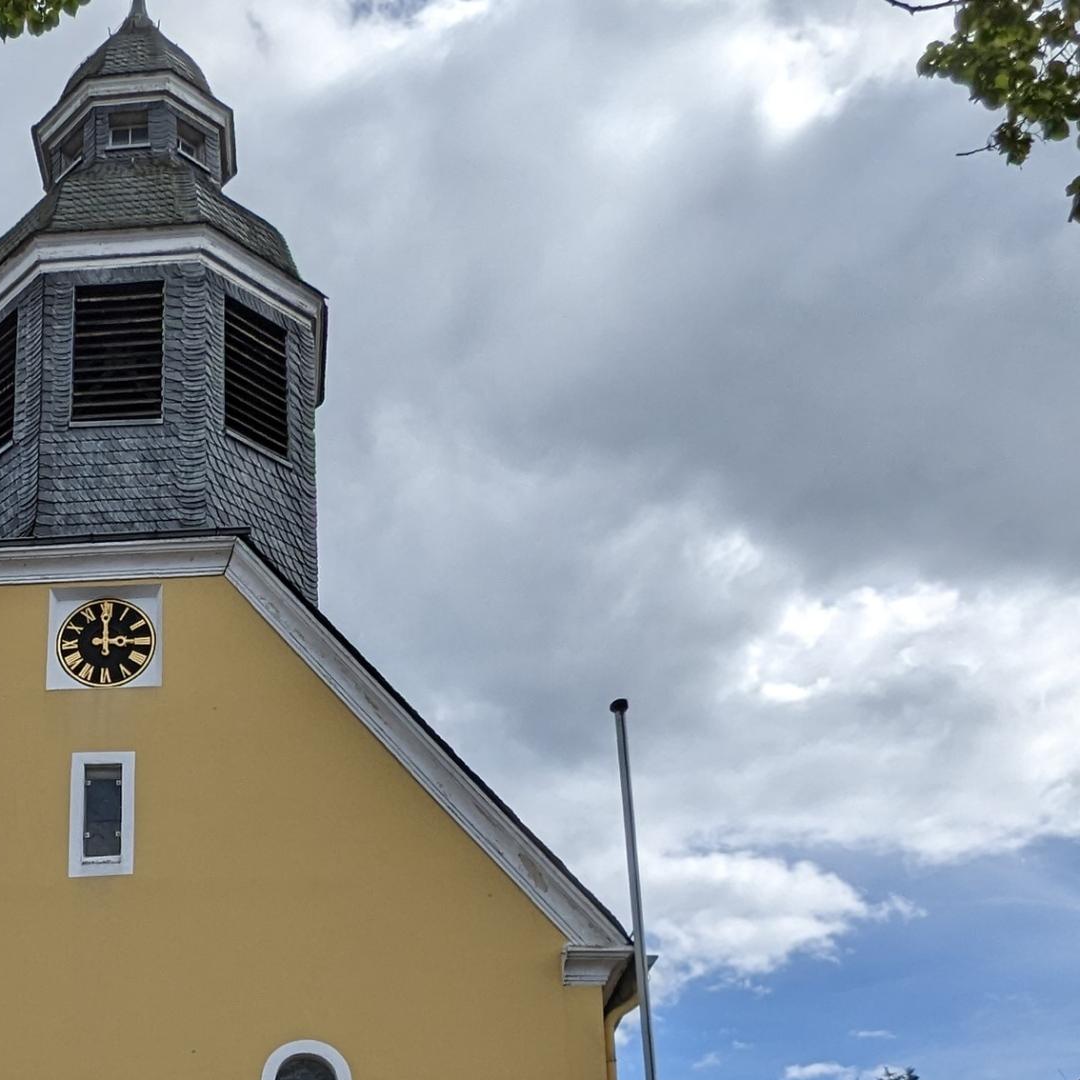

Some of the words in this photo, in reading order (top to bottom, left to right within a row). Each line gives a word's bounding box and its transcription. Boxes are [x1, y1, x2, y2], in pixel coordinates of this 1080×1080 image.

[81, 608, 96, 623] XI
[120, 608, 129, 621] I
[67, 622, 83, 634] X
[130, 619, 145, 631] II
[62, 639, 78, 649] IX
[134, 637, 150, 645] III
[65, 651, 84, 670] VIII
[129, 651, 147, 665] IIII
[79, 663, 94, 680] VII
[100, 668, 111, 683] VI
[120, 664, 132, 678] V
